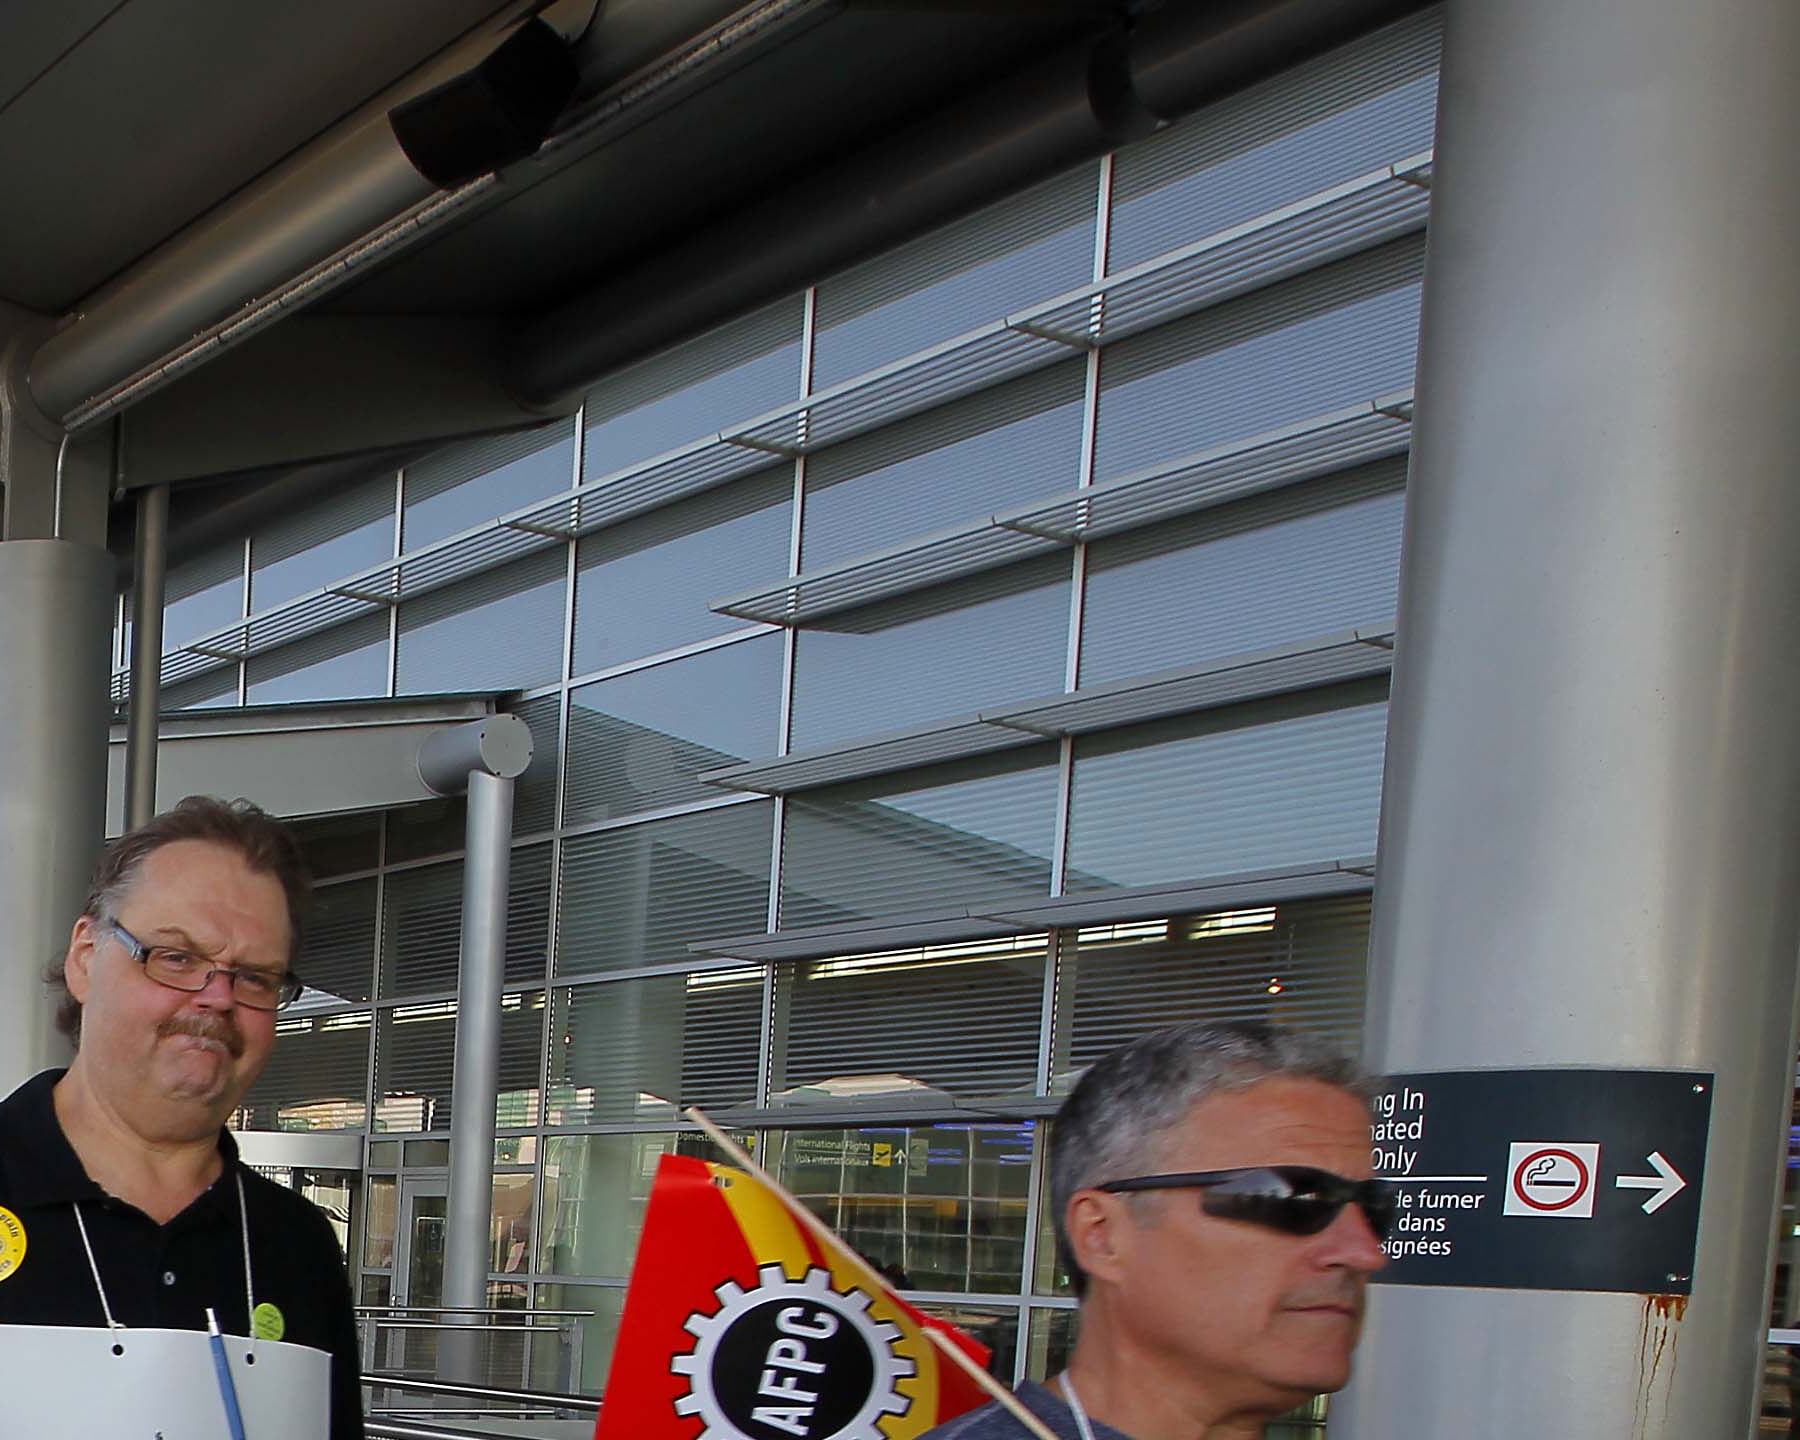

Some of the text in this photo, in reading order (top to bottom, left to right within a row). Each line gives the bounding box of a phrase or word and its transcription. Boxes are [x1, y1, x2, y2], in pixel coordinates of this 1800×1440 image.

[1402, 1087, 1425, 1111] In
[1418, 1189, 1485, 1209] fumer
[1398, 1212, 1446, 1232] dans
[1378, 1236, 1452, 1259] signées
[750, 1305, 839, 1437] AFPC
